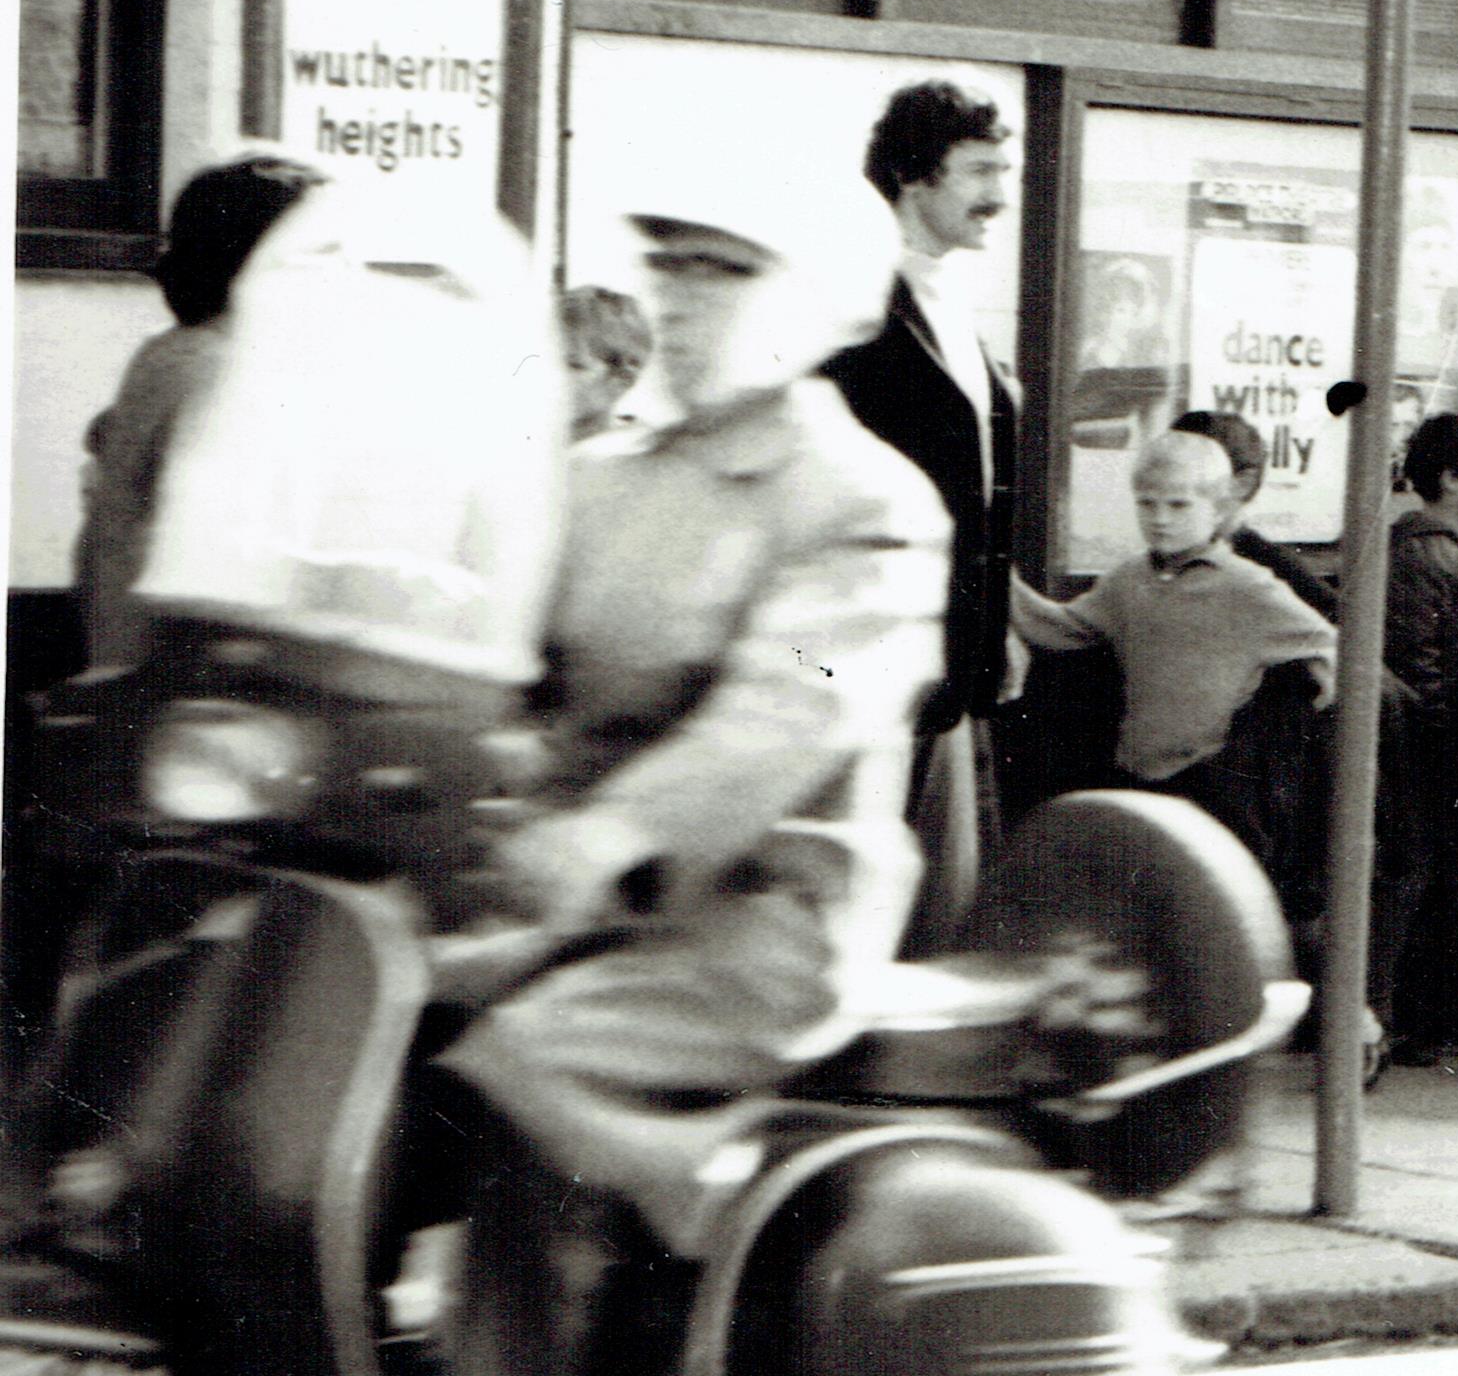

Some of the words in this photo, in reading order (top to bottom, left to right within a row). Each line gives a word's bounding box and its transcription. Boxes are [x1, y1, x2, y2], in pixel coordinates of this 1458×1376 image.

[291, 40, 497, 108] wuthering
[316, 107, 464, 172] heights
[1221, 320, 1325, 368] dance
[1212, 373, 1299, 417] with
[1268, 424, 1315, 474] lly
